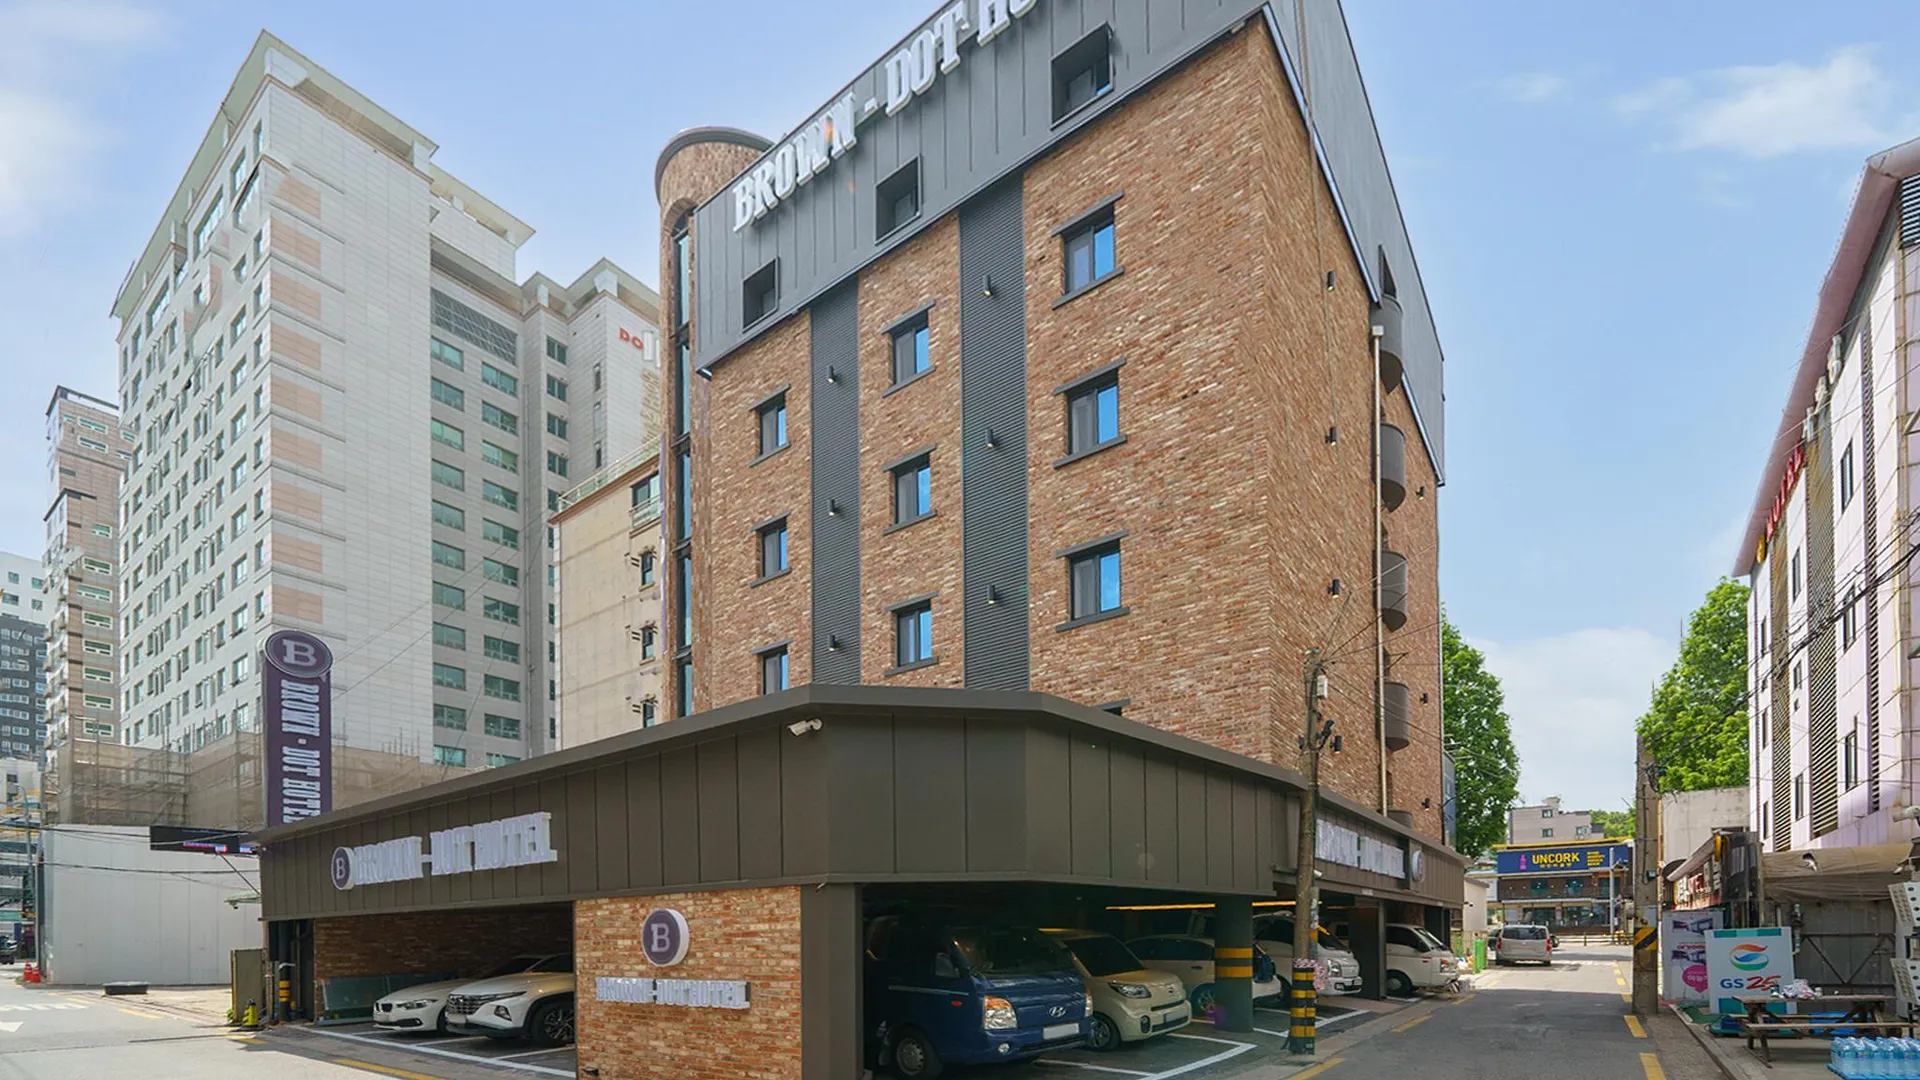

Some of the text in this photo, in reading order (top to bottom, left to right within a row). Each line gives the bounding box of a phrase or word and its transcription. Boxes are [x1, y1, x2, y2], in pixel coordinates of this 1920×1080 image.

[732, 91, 857, 232] BROWN
[885, 2, 970, 118] DOT
[282, 638, 318, 667] B
[281, 679, 320, 736] BROWN
[282, 746, 320, 777] DOT
[1532, 852, 1580, 864] UNCORK
[650, 923, 671, 952] B
